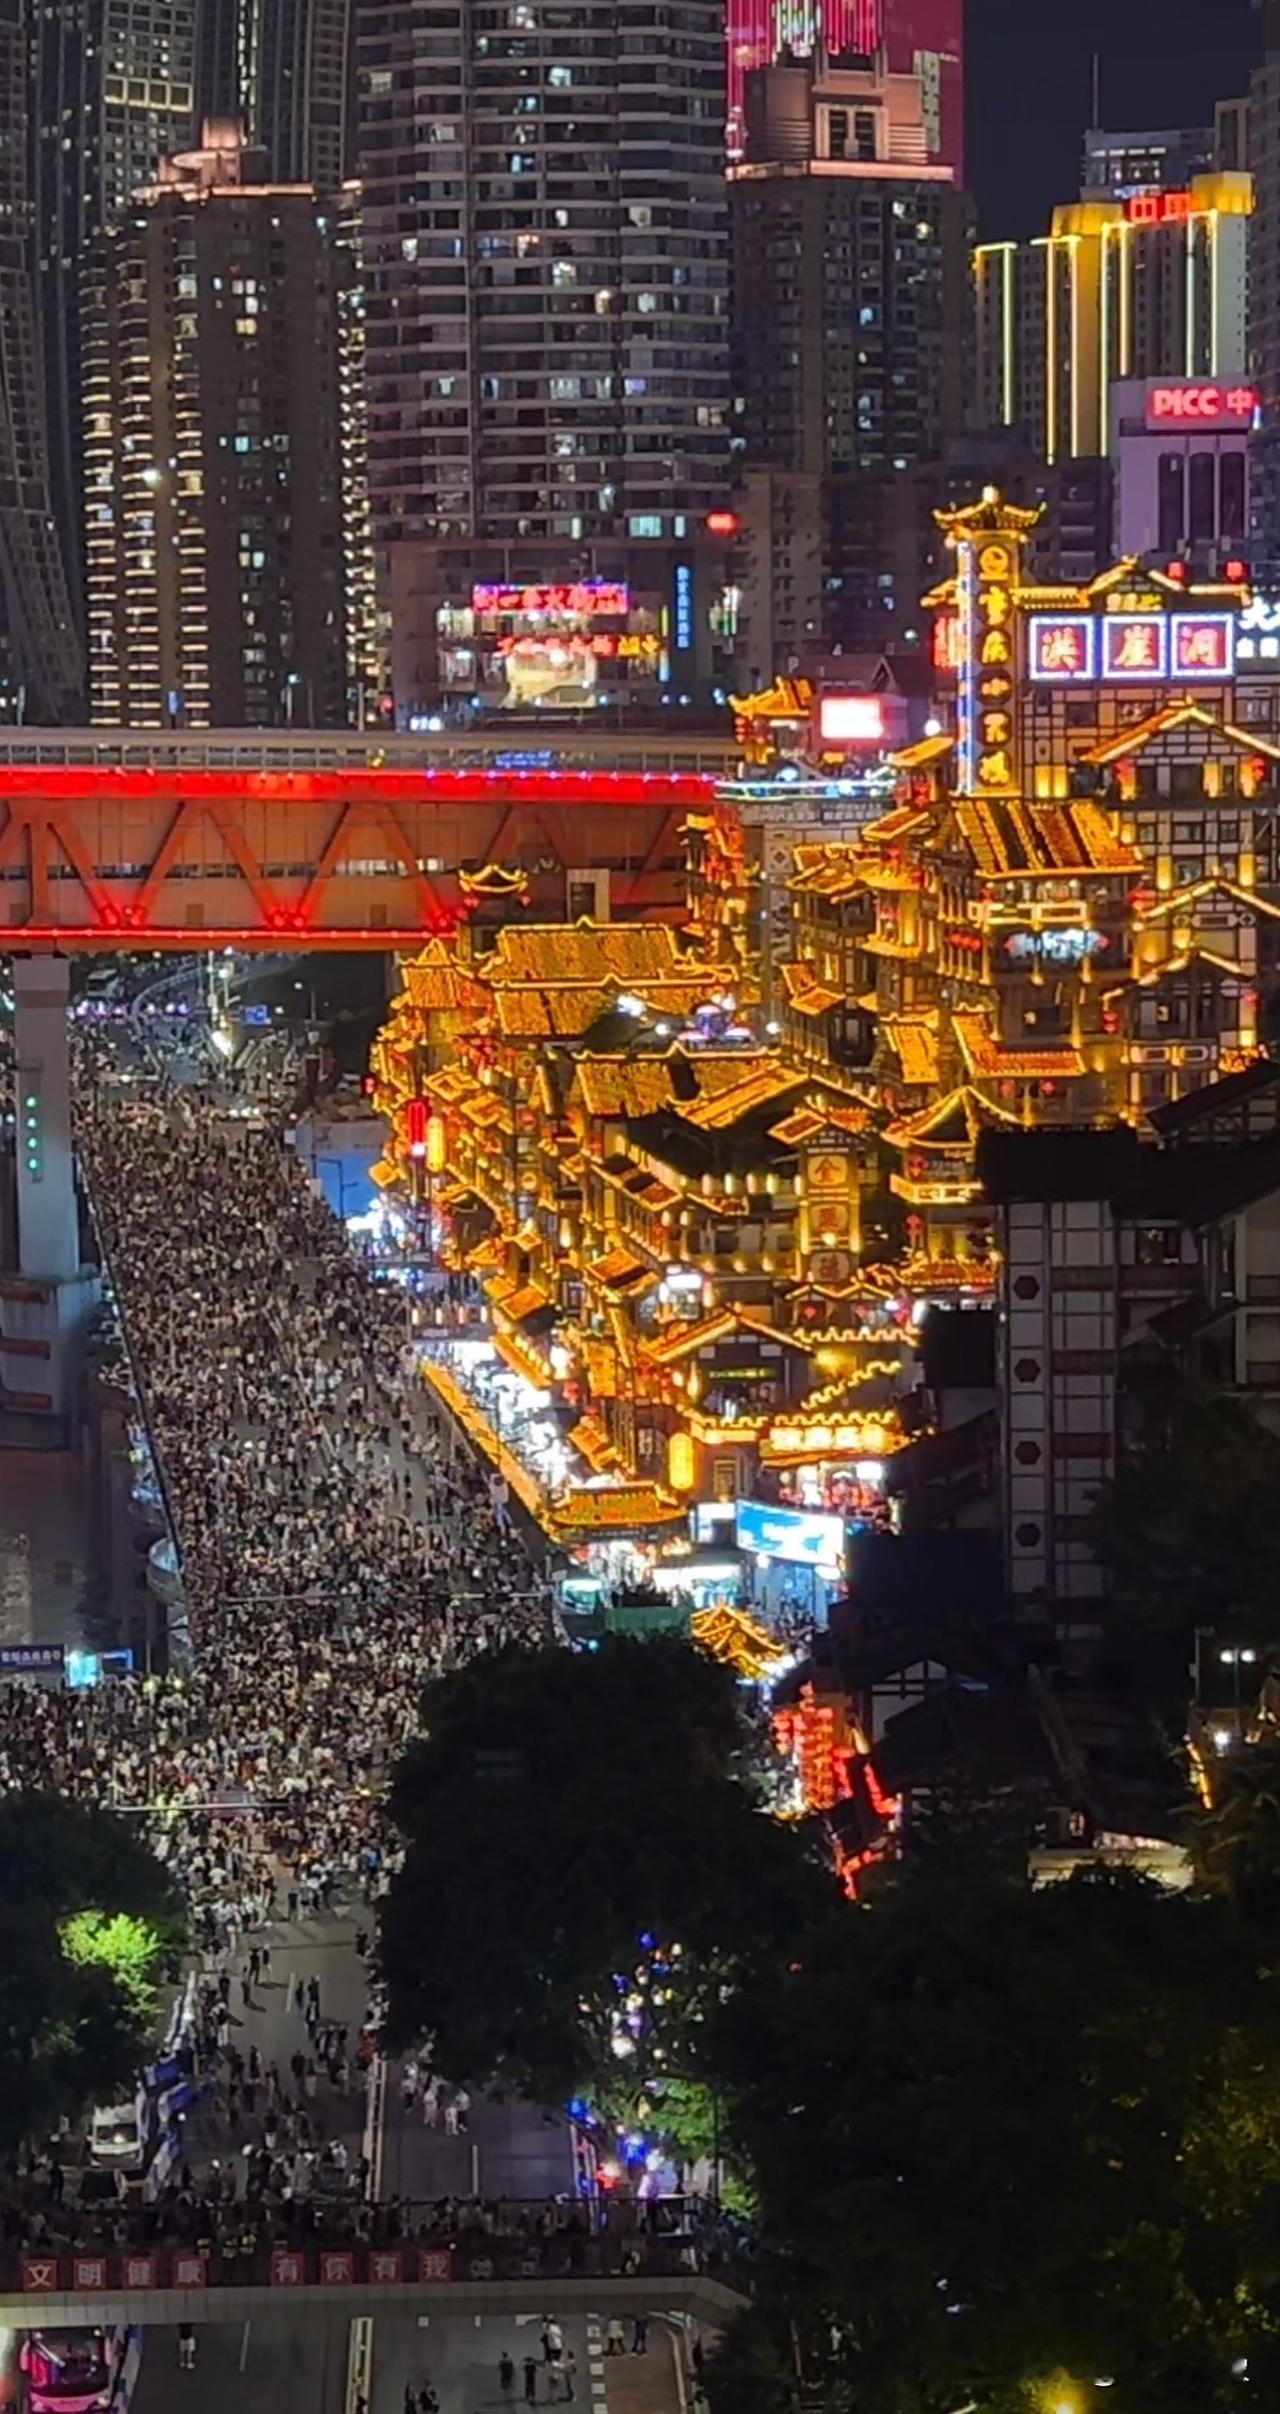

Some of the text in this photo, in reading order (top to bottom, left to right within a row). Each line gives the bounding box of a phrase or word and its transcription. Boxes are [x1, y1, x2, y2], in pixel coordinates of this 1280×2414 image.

[1154, 388, 1219, 416] PICC
[1041, 624, 1219, 669] 洪崖洞
[28, 2260, 203, 2288] 文明健康
[275, 2254, 449, 2282] 有你有我
